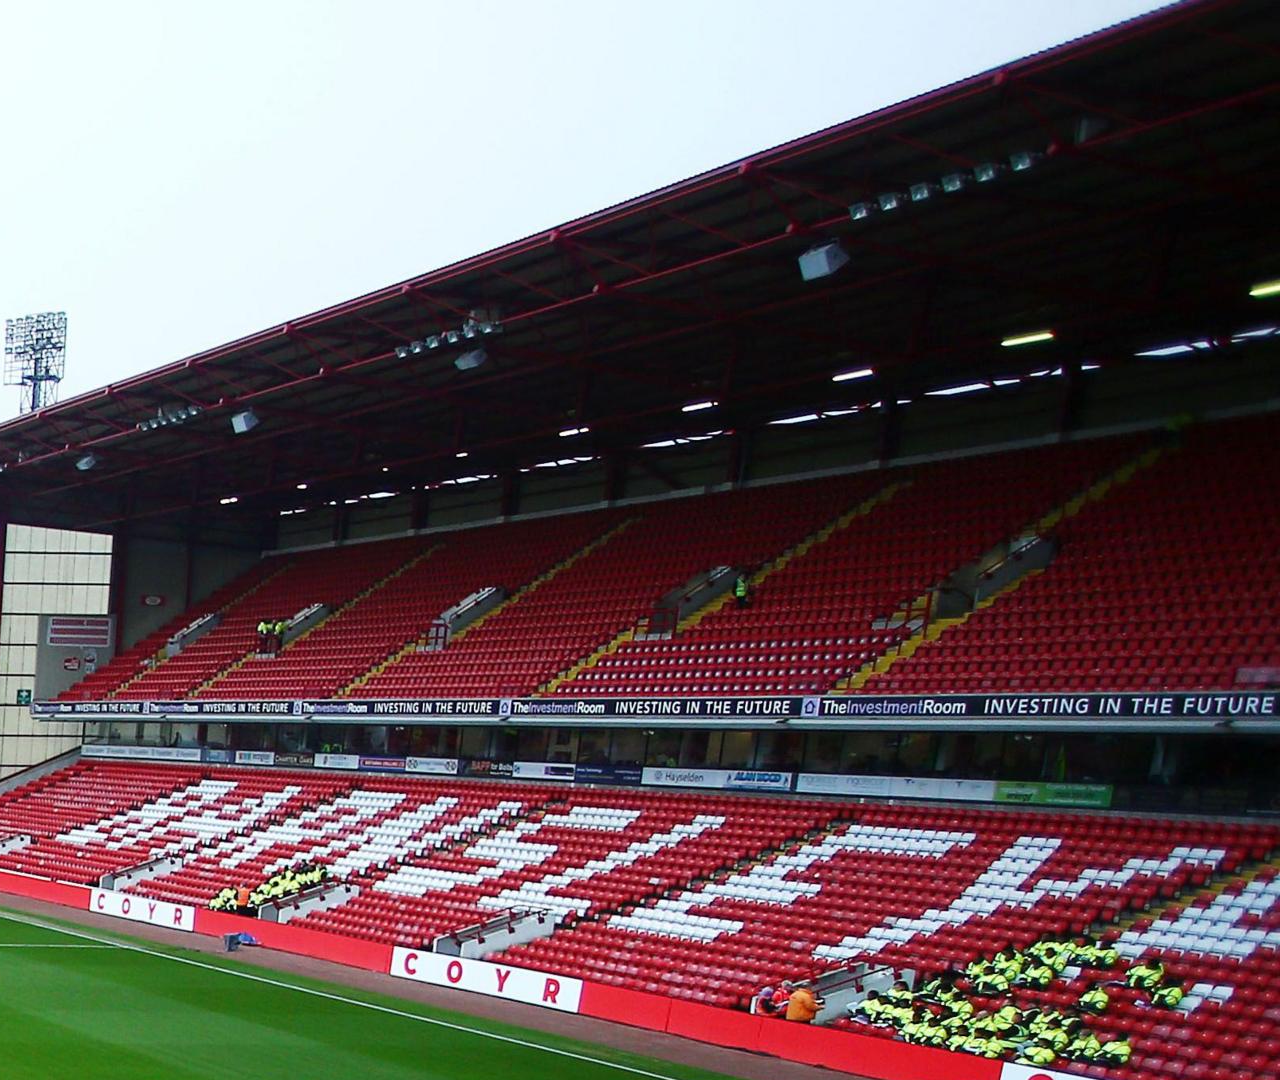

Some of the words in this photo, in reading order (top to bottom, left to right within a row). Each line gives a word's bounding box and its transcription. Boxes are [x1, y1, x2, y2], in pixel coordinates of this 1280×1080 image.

[75, 704, 101, 713] INVESTING
[102, 704, 108, 713] IN
[109, 704, 119, 713] THE
[120, 704, 140, 713] FUTURE
[203, 703, 236, 713] INVESTING
[238, 703, 246, 713] IN
[247, 703, 261, 713] THE
[262, 703, 289, 713] FUTURE
[303, 703, 368, 714] TheInvestmentRoom
[374, 703, 419, 714] INVESTING
[422, 703, 432, 714] IN
[436, 703, 454, 714] THE
[456, 703, 493, 714] FUTURE
[513, 702, 605, 714] TheInvestmentRoom
[615, 702, 682, 714] INVESTING
[686, 702, 700, 714] IN
[705, 702, 731, 714] THE
[736, 702, 791, 714] FUTURE
[823, 699, 966, 714] TheInvestmentRoom
[984, 699, 1089, 714] INVESTING
[1098, 699, 1121, 714] IN
[1132, 699, 1174, 714] THE
[1183, 699, 1275, 714] FUTURE
[665, 772, 704, 783] Hayselden
[97, 893, 183, 926] COYR
[404, 953, 560, 1004] COYR
